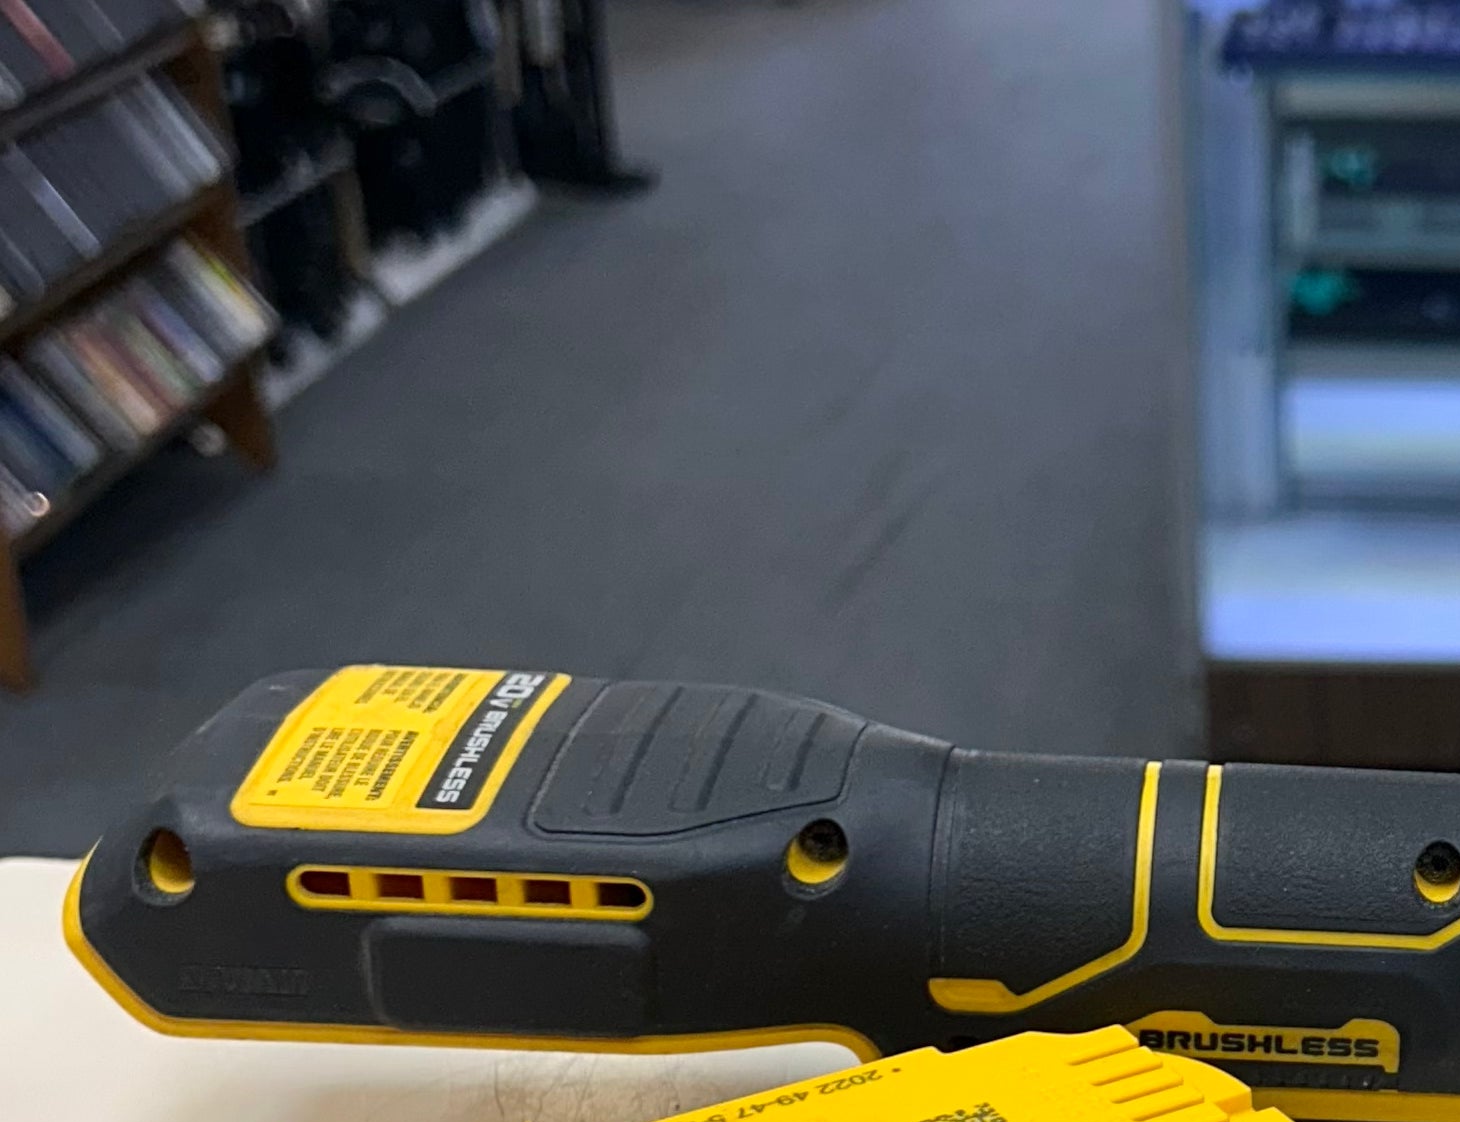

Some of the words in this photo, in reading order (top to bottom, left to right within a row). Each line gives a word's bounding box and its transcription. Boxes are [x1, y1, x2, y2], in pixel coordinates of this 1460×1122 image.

[435, 710, 509, 803] BRUSHLESS
[1139, 1029, 1379, 1058] BRUSHLESS
[815, 1069, 884, 1095] 2022
